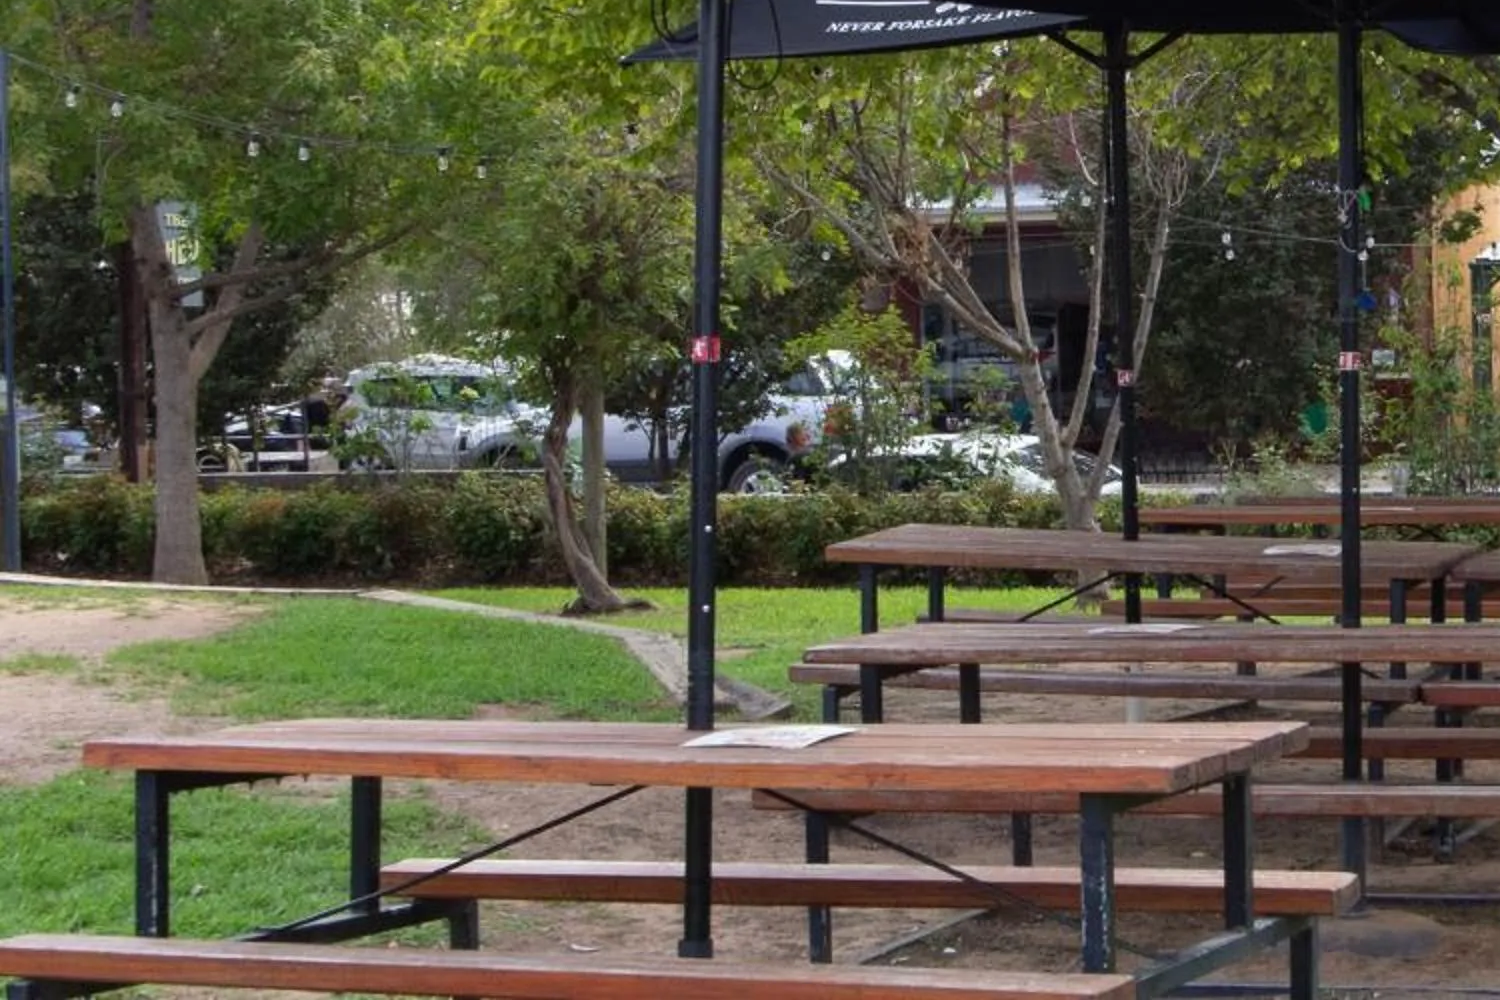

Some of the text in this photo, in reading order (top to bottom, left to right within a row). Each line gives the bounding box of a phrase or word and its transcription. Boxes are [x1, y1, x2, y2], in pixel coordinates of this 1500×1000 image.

[825, 8, 1037, 34] NEVER FORSAKE FLAV
